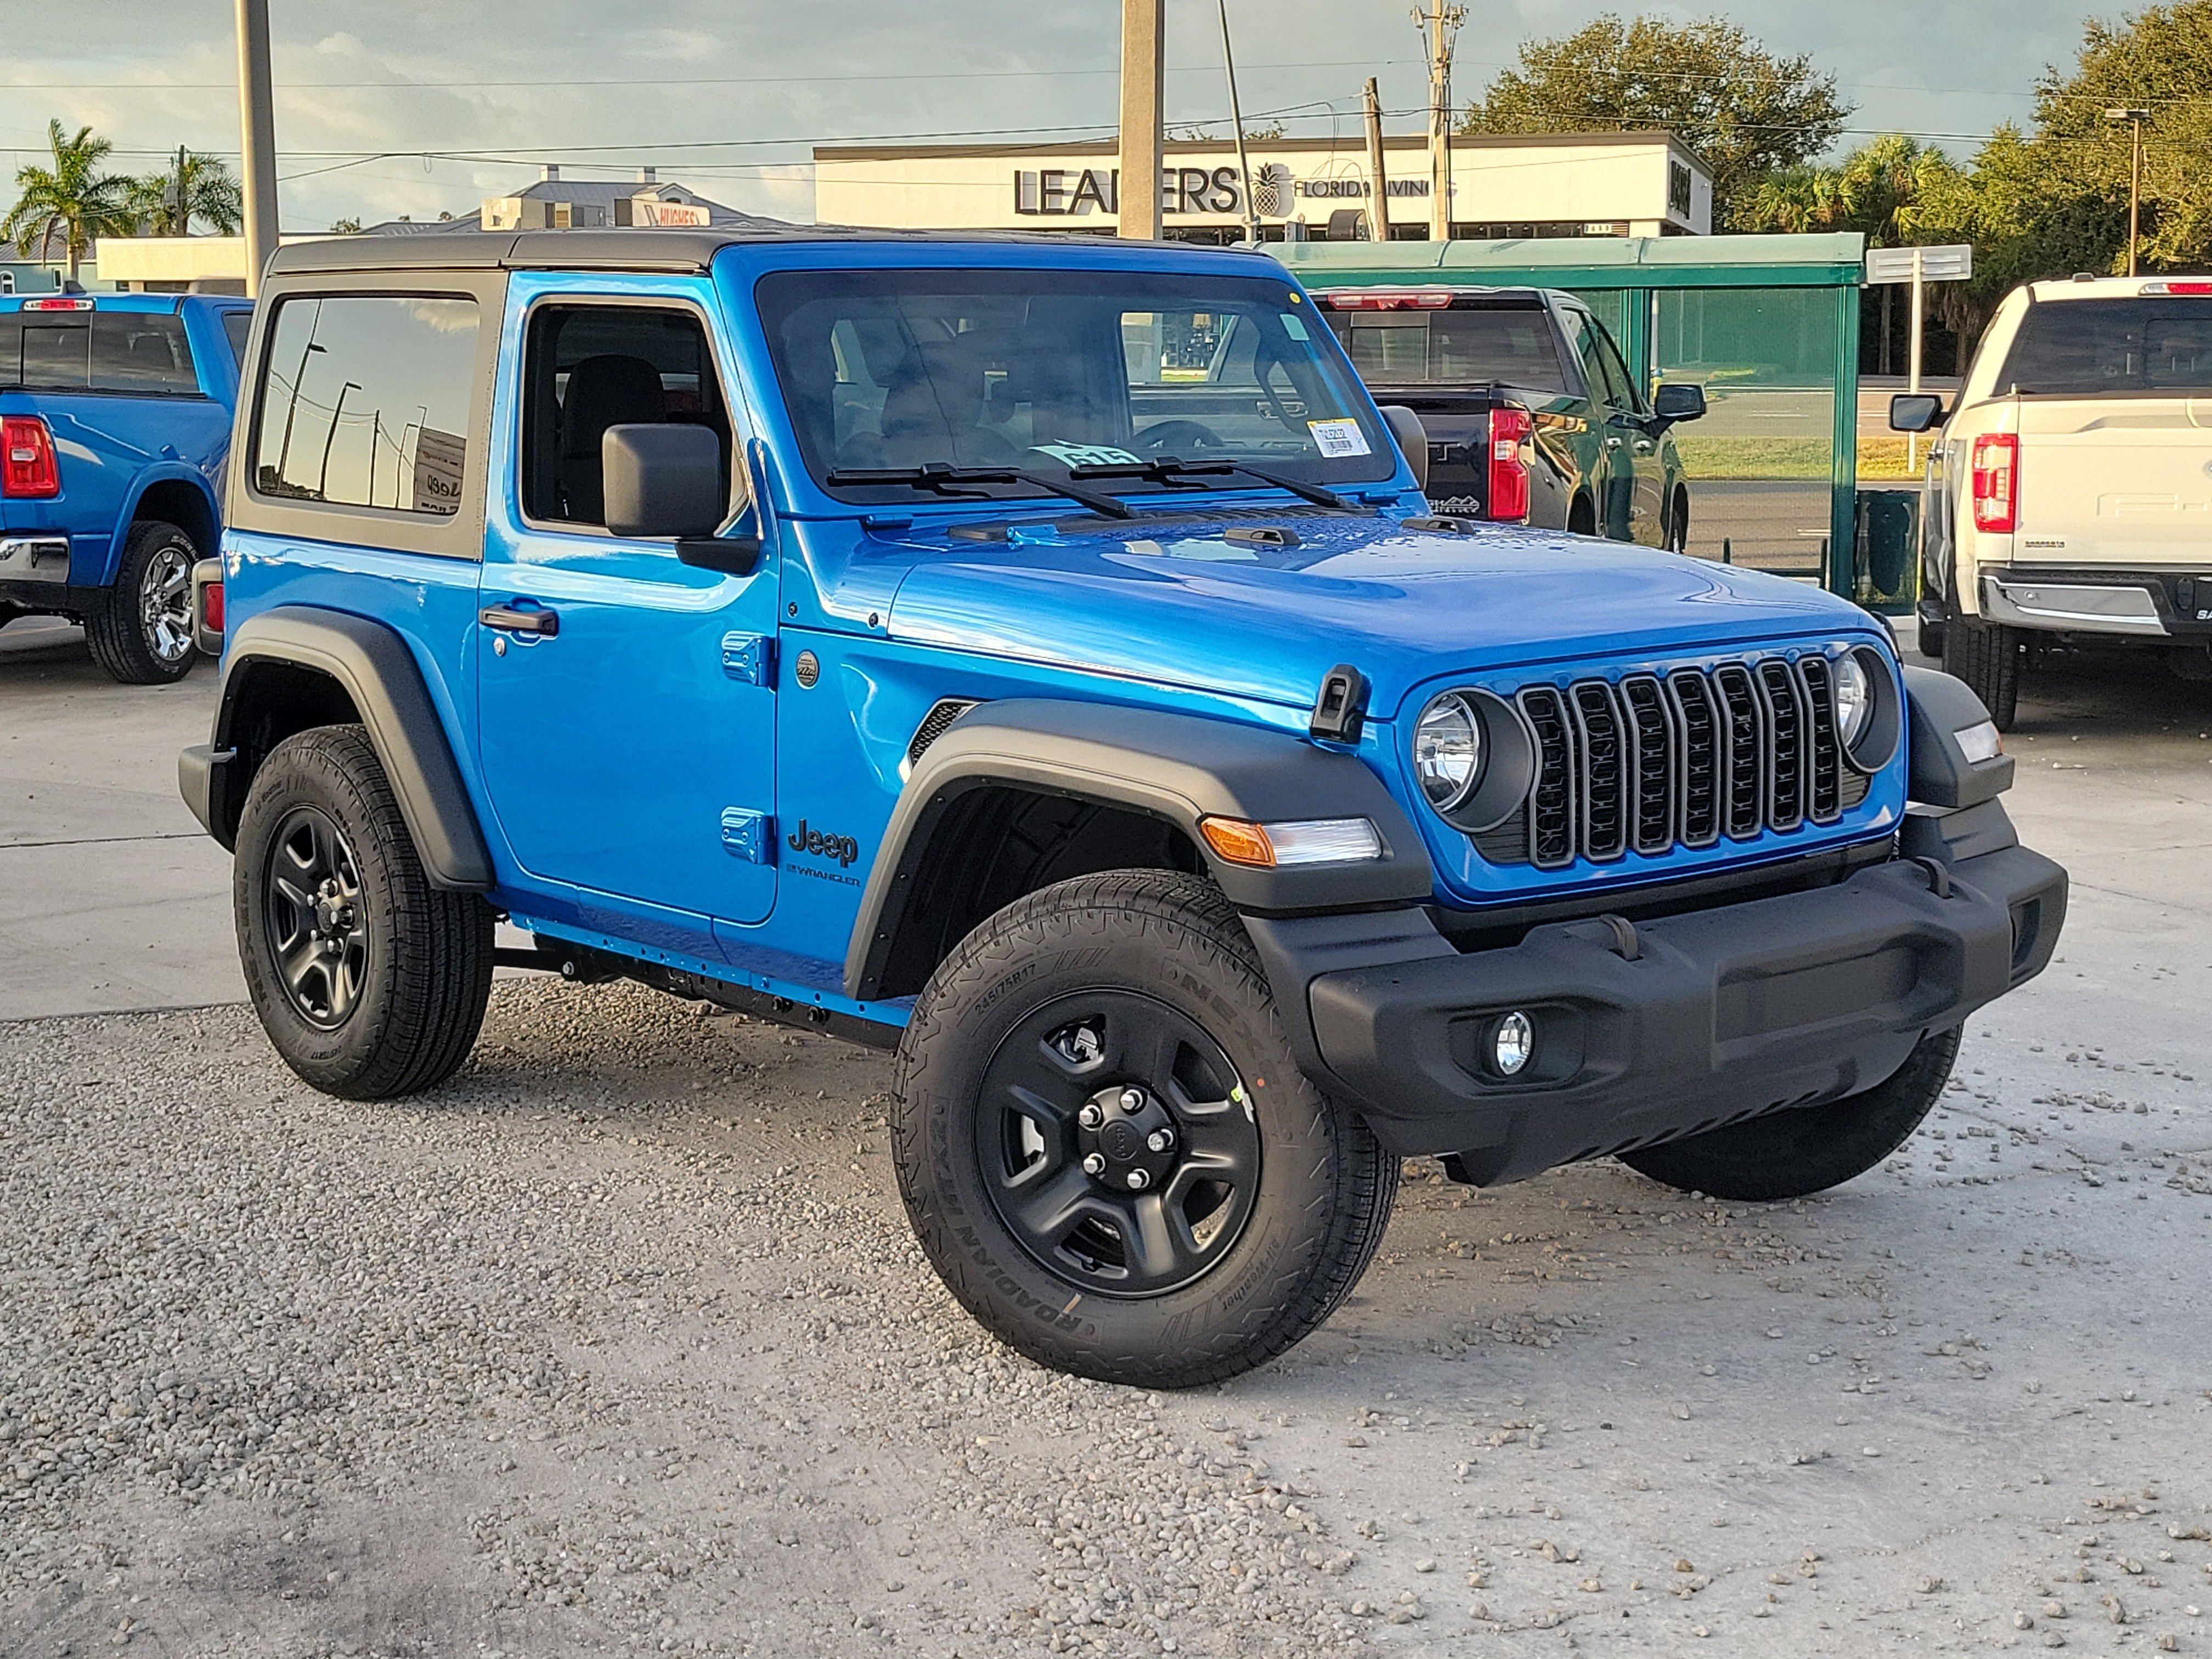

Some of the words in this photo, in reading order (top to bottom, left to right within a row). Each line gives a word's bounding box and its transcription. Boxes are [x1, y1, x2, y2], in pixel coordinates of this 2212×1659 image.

[1014, 167, 1238, 214] LEAERS
[1294, 180, 1370, 197] FLORIDA
[788, 818, 858, 868] Jeep
[797, 865, 861, 887] WRANGLER
[973, 961, 1040, 1017] 245/75R17
[952, 1218, 1082, 1335] ROADIAN
